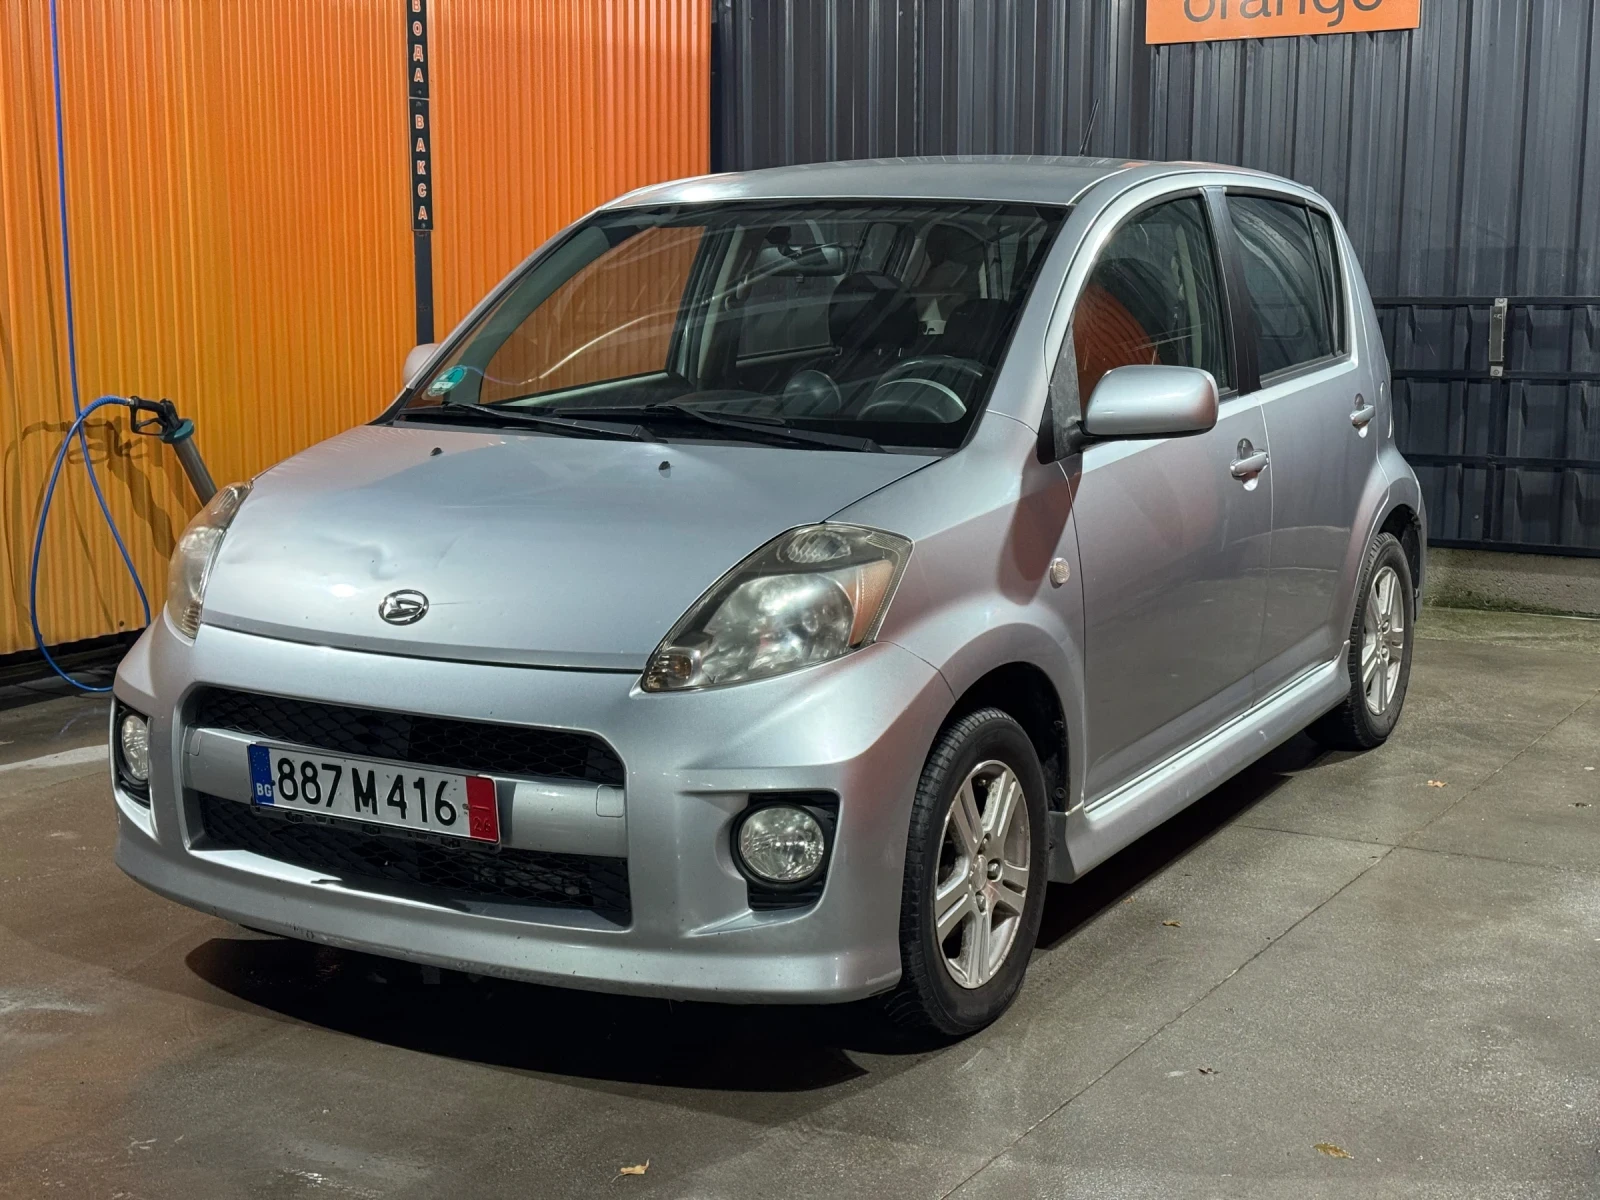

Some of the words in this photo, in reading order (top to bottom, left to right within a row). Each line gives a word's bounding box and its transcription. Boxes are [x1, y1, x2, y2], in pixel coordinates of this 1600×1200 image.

[412, 0, 424, 83] ВОДА
[415, 114, 428, 220] ВАКСА
[256, 783, 272, 797] BG
[277, 757, 343, 808] 887
[351, 767, 379, 815] M
[386, 774, 457, 826] 416
